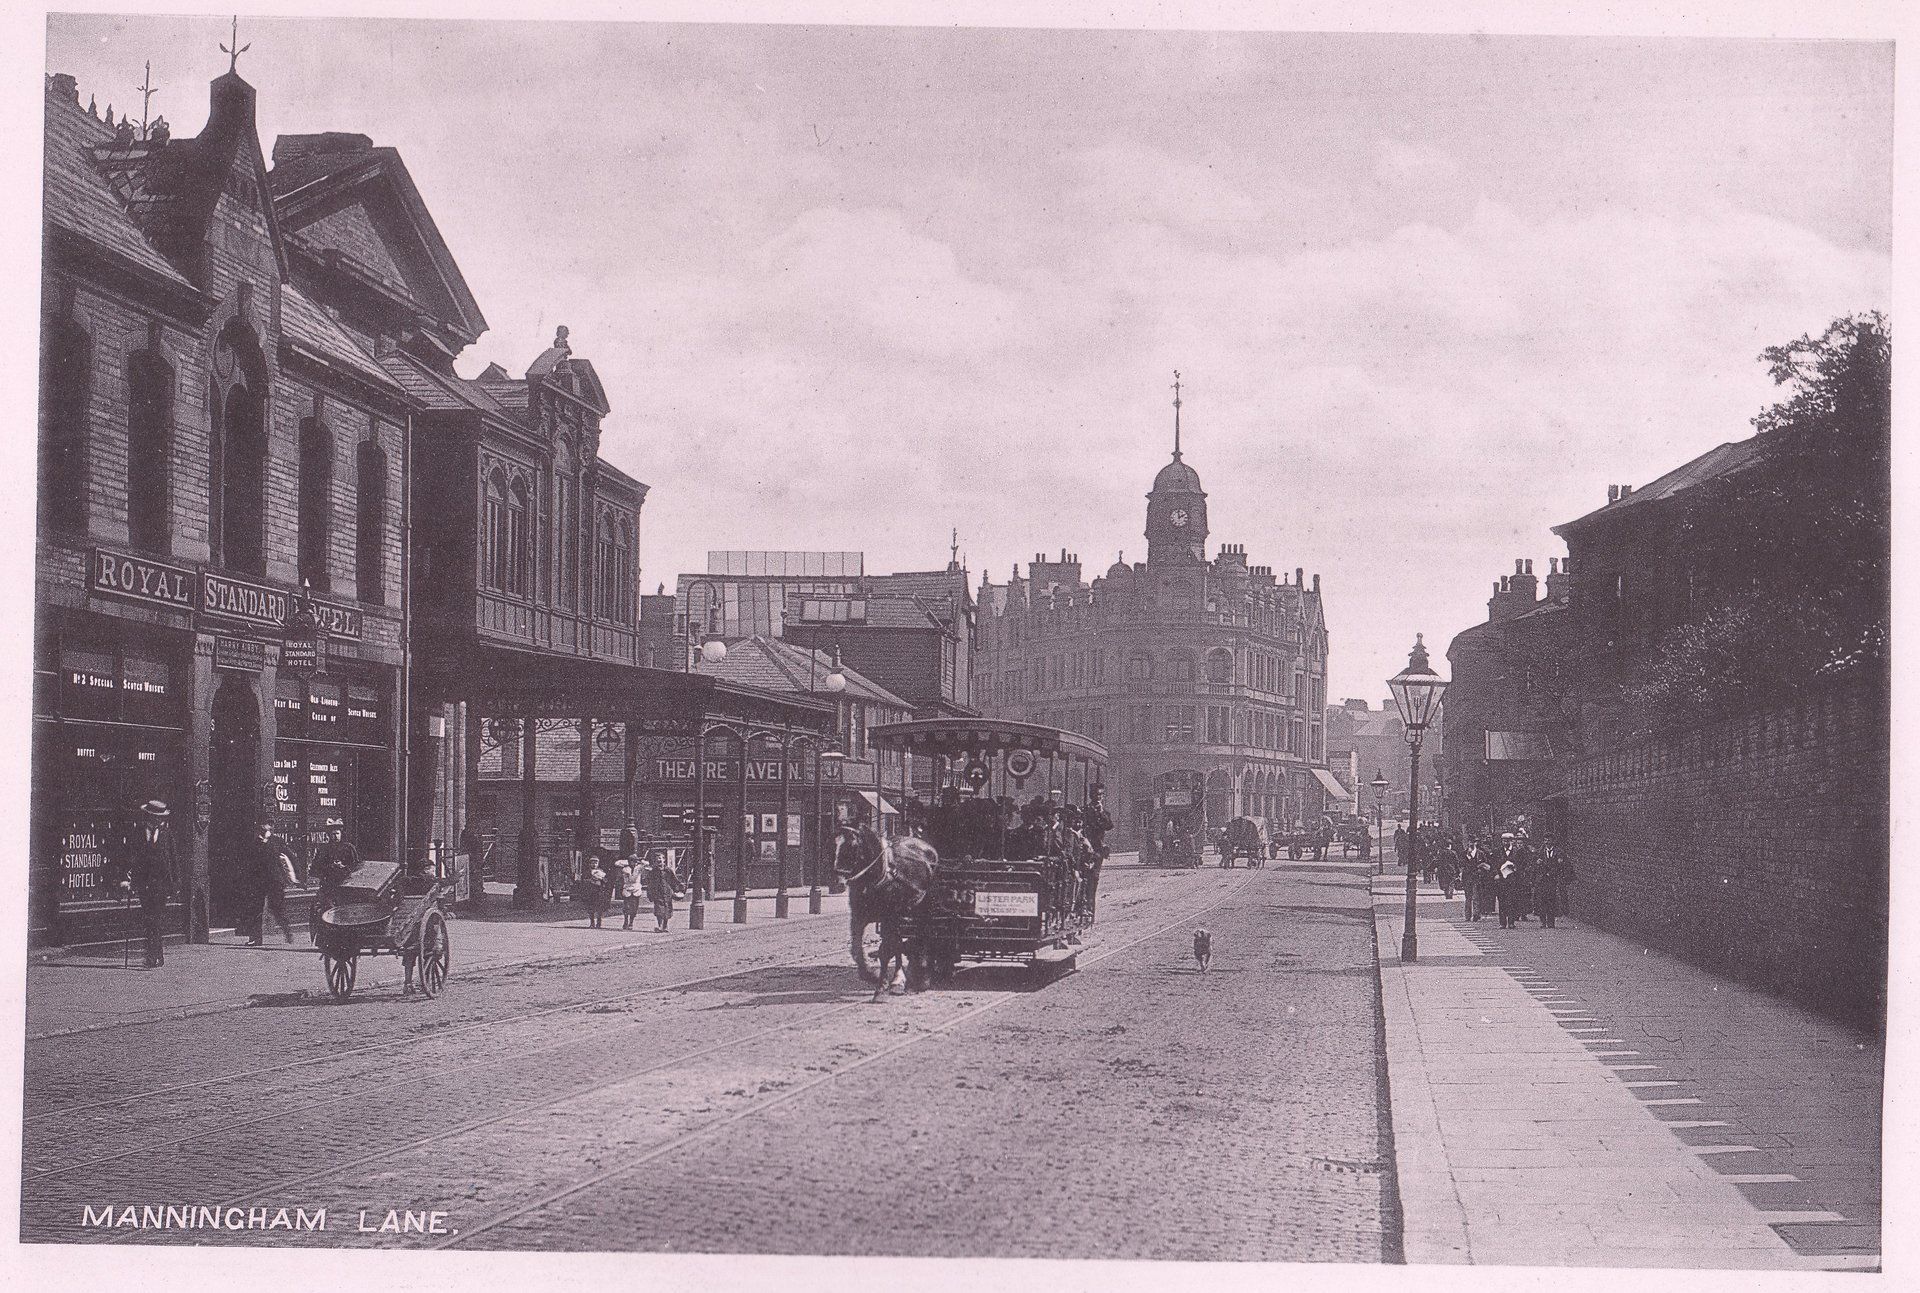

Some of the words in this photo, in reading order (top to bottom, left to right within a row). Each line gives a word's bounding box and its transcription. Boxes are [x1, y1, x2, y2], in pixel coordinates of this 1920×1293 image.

[98, 553, 189, 602] ROYAL
[205, 578, 286, 622] STANDARD
[69, 834, 98, 849] ROYAL
[65, 853, 102, 869] STANDARD
[68, 873, 96, 889] HOTEL
